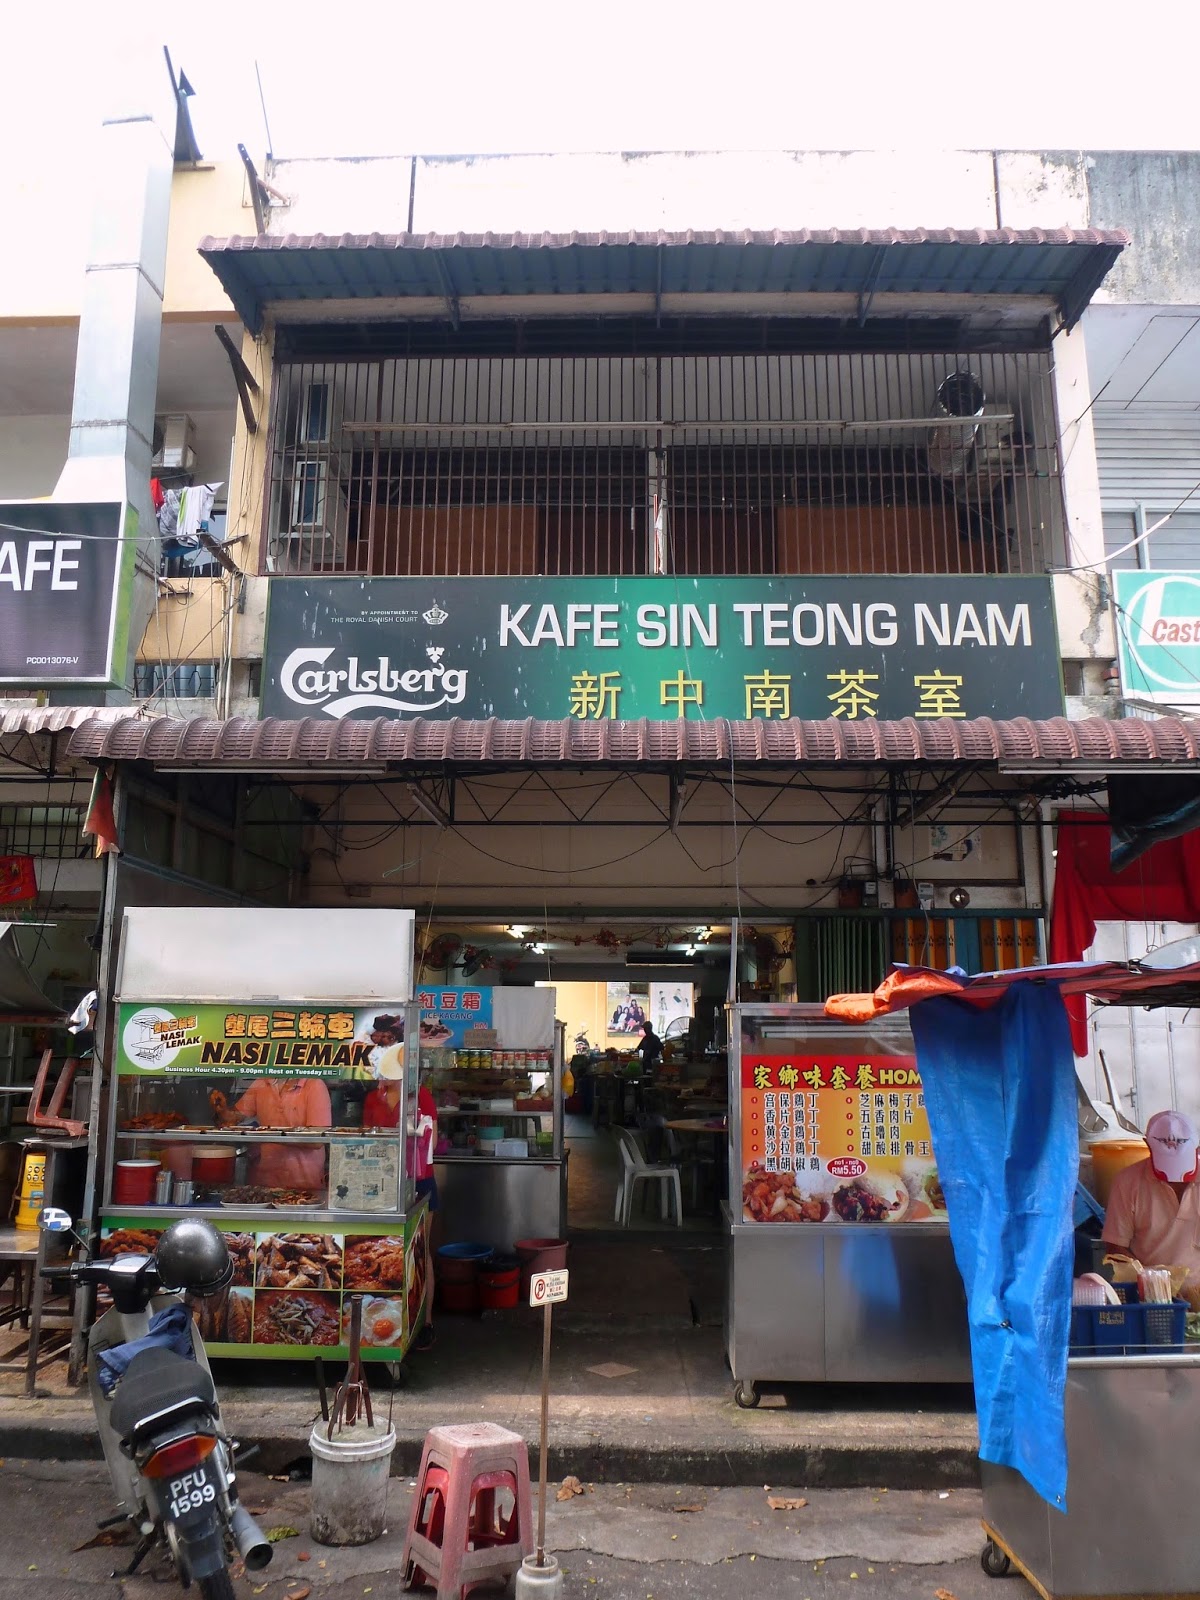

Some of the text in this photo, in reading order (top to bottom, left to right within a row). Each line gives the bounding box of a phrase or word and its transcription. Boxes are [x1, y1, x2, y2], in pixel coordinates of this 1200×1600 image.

[500, 603, 1032, 647] KAFE SIN TEONG NAM
[280, 647, 469, 706] Carlsberg
[569, 669, 967, 719] 新中南茶室
[418, 991, 481, 1010] 紅豆霜
[161, 1031, 185, 1042] NASI
[166, 1036, 201, 1049] LEMAK
[200, 1041, 378, 1068] NASI LEMAK
[860, 1109, 913, 1124] 五香肉片
[861, 1141, 930, 1156] 甜酸排骨王
[832, 1165, 862, 1175] RM5.50
[170, 1468, 206, 1498] PFU
[170, 1484, 215, 1518] 1599
